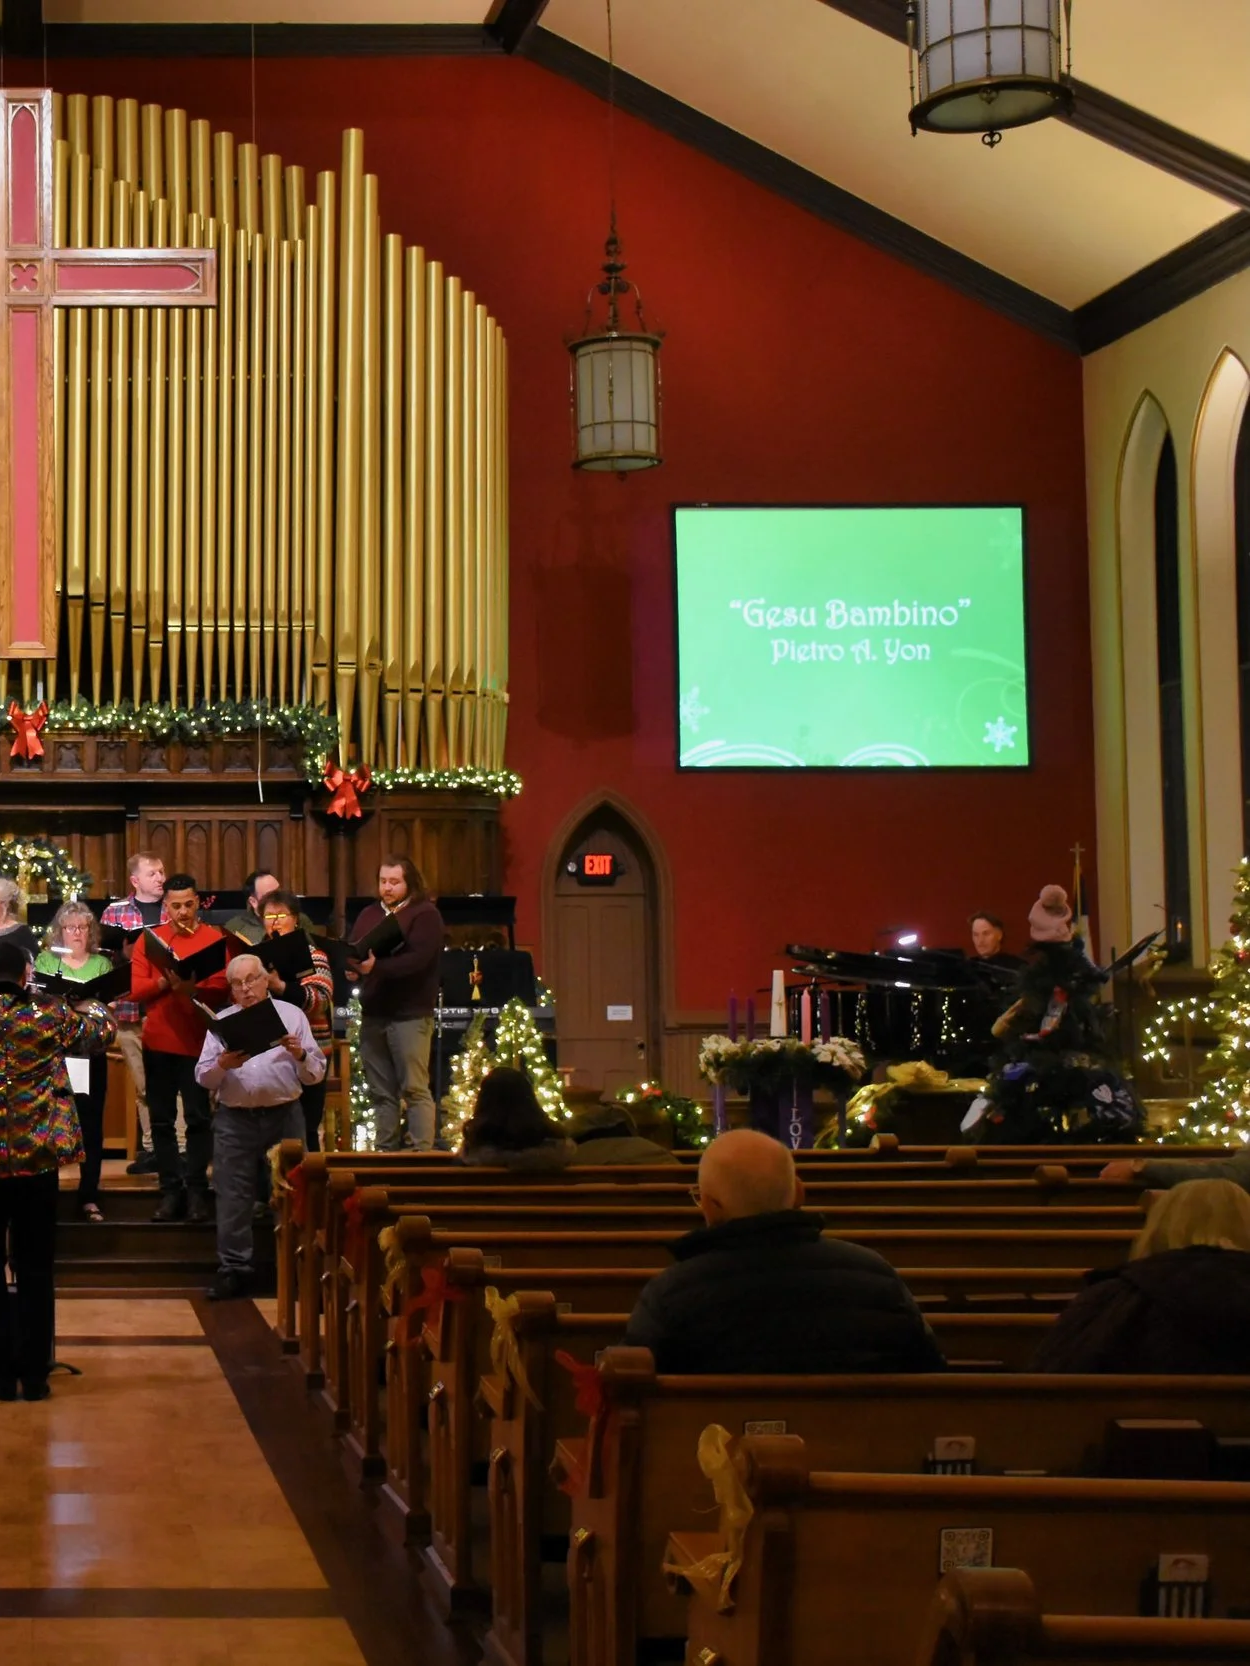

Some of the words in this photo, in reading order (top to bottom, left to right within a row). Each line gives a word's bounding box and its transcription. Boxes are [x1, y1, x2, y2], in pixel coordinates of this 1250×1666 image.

[729, 598, 817, 630] “Gesu
[825, 598, 971, 630] Bambino”
[770, 638, 845, 665] Pietro
[850, 638, 877, 664] A.
[883, 638, 931, 665] Yon
[584, 855, 612, 875] EXIT
